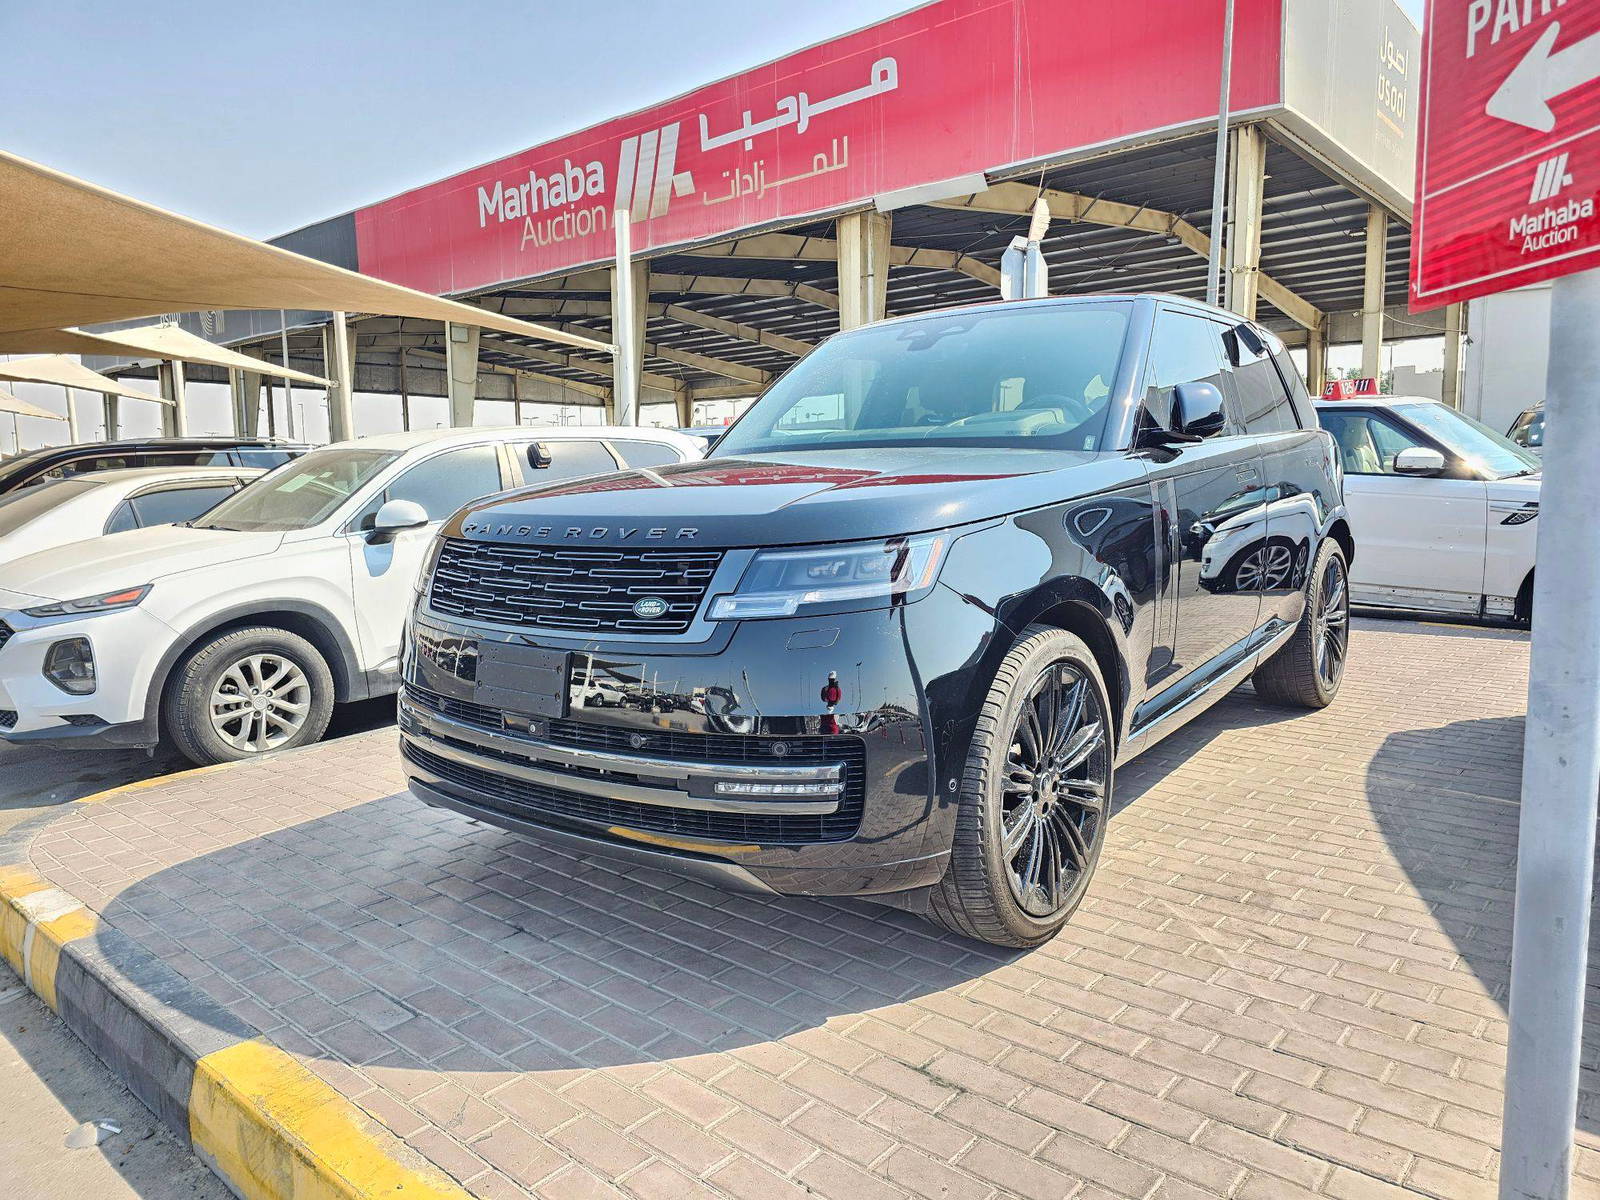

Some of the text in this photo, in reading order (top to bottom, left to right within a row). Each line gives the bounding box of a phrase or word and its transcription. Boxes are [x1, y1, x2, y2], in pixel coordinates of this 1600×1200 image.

[699, 57, 898, 152] مرحبا
[477, 159, 605, 228] Marhaba
[703, 136, 848, 206] للمزادات
[520, 203, 607, 252] Auction
[1509, 198, 1594, 241] Marhaba
[1520, 224, 1578, 255] Auction
[464, 522, 700, 540] RANGE ROVER
